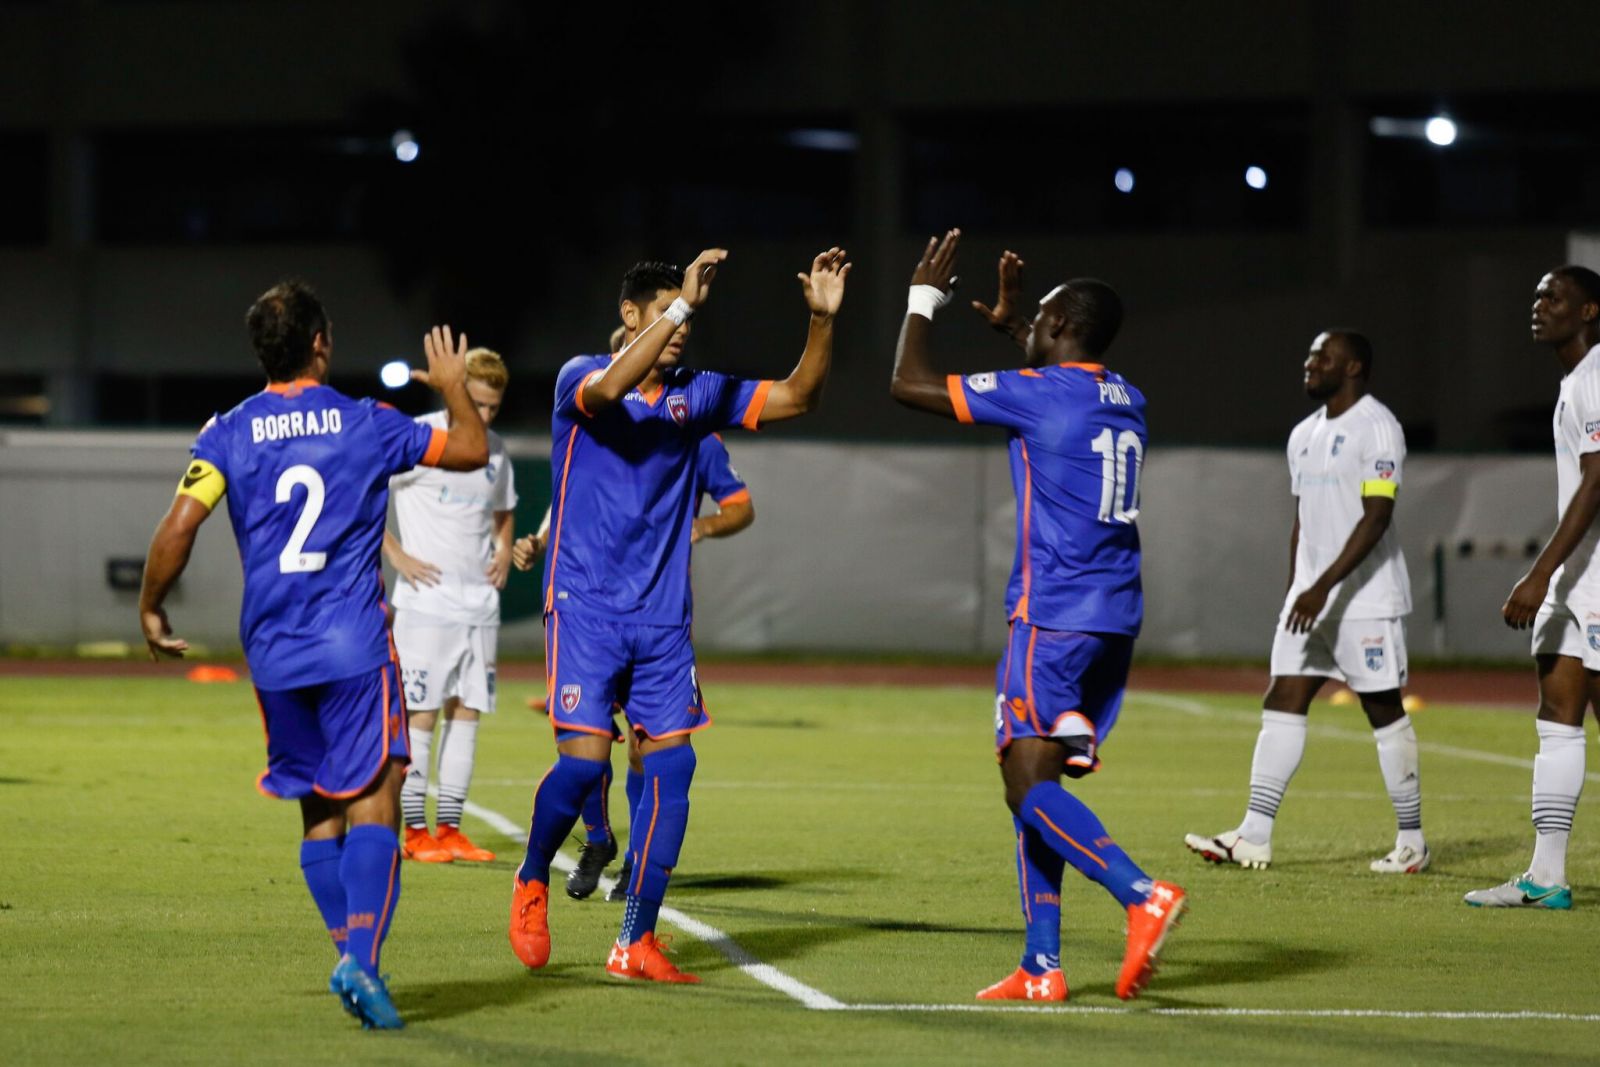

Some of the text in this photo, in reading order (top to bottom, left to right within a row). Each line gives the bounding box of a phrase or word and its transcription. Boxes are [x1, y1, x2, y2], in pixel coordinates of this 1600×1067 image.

[251, 408, 342, 444] BORRAJO
[275, 464, 327, 574] 2
[1091, 427, 1143, 524] 10
